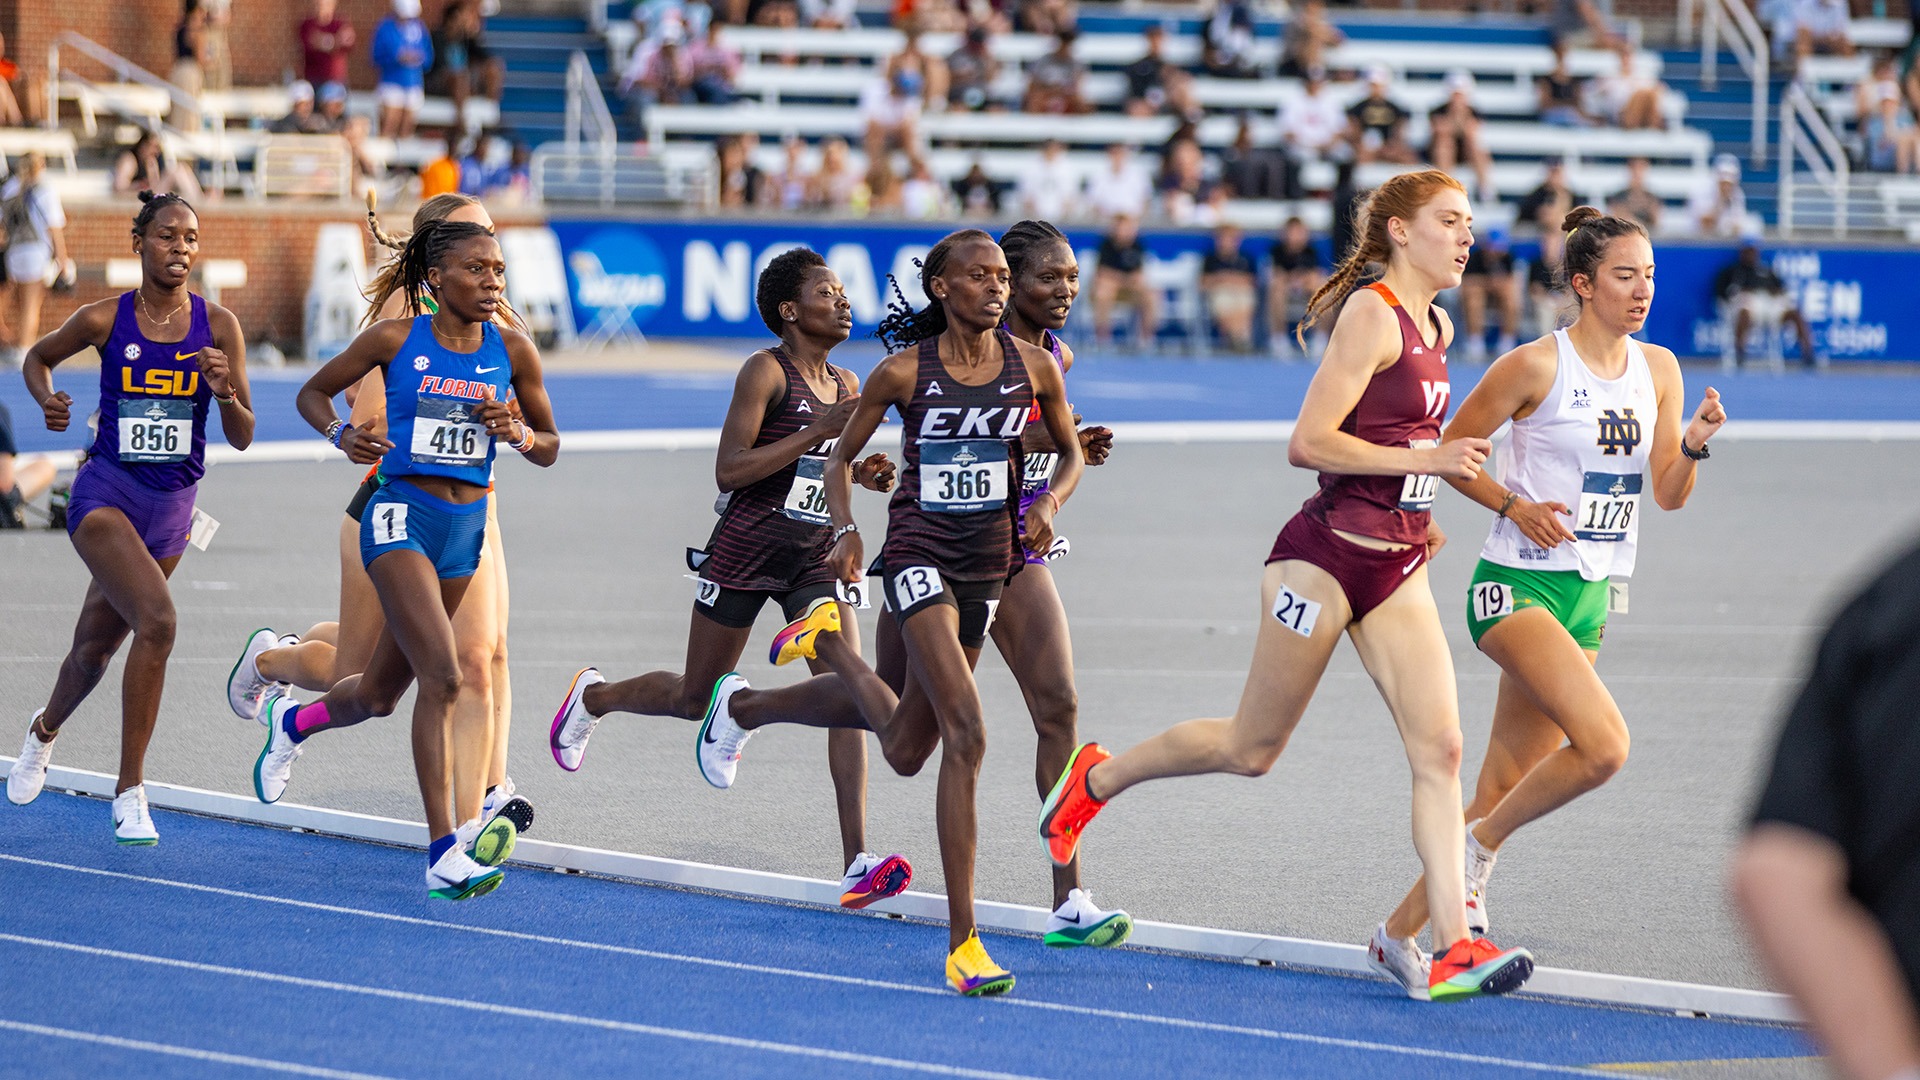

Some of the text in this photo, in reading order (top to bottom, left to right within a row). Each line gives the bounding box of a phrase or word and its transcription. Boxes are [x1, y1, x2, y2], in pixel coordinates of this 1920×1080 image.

[122, 366, 199, 396] LSU
[418, 375, 497, 400] FLORIDA
[1420, 380, 1450, 418] VT
[1570, 399, 1592, 408] ACC
[920, 407, 1031, 436] EKU
[131, 424, 178, 452] 856
[430, 426, 476, 455] 416
[938, 469, 991, 500] 366
[799, 485, 831, 514] 36
[382, 508, 397, 539] 1
[1584, 500, 1634, 529] 1178
[900, 569, 931, 602] 13
[1276, 591, 1307, 630] 21
[1478, 585, 1504, 616] 19
